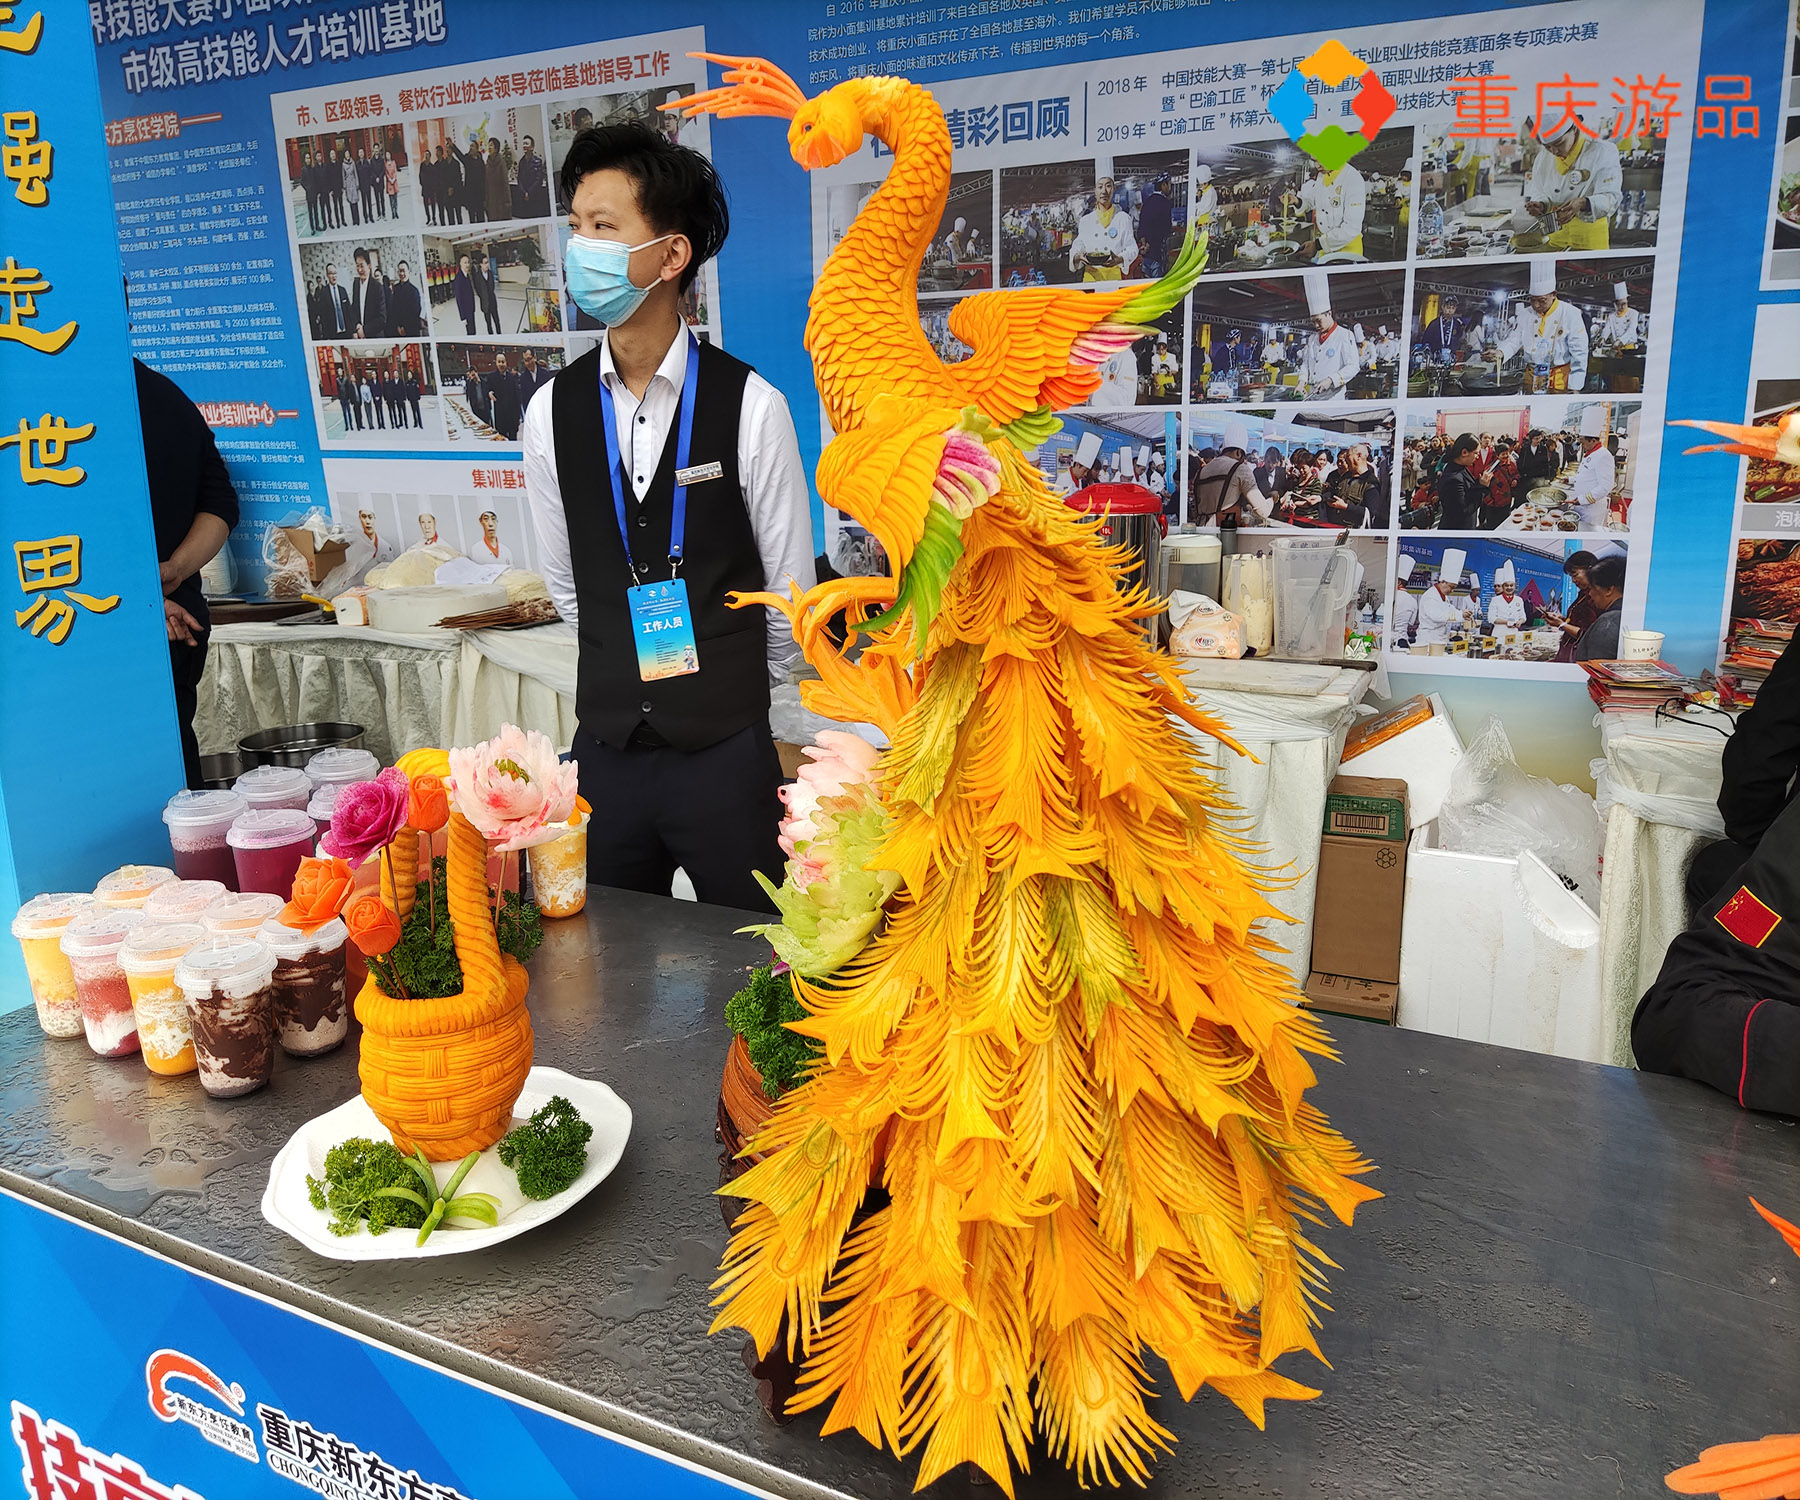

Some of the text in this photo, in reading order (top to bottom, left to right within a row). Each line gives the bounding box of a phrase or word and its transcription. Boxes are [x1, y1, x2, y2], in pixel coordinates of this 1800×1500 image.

[826, 5, 836, 16] 自
[841, 1, 864, 14] 2016
[122, 0, 446, 93] 市级高技能人才培训基地
[296, 51, 670, 127] 市、区级领导，餐饮行业协会领导莅临基地指导工作
[197, 403, 275, 425] 业培训中心
[642, 616, 683, 634] 工作人员
